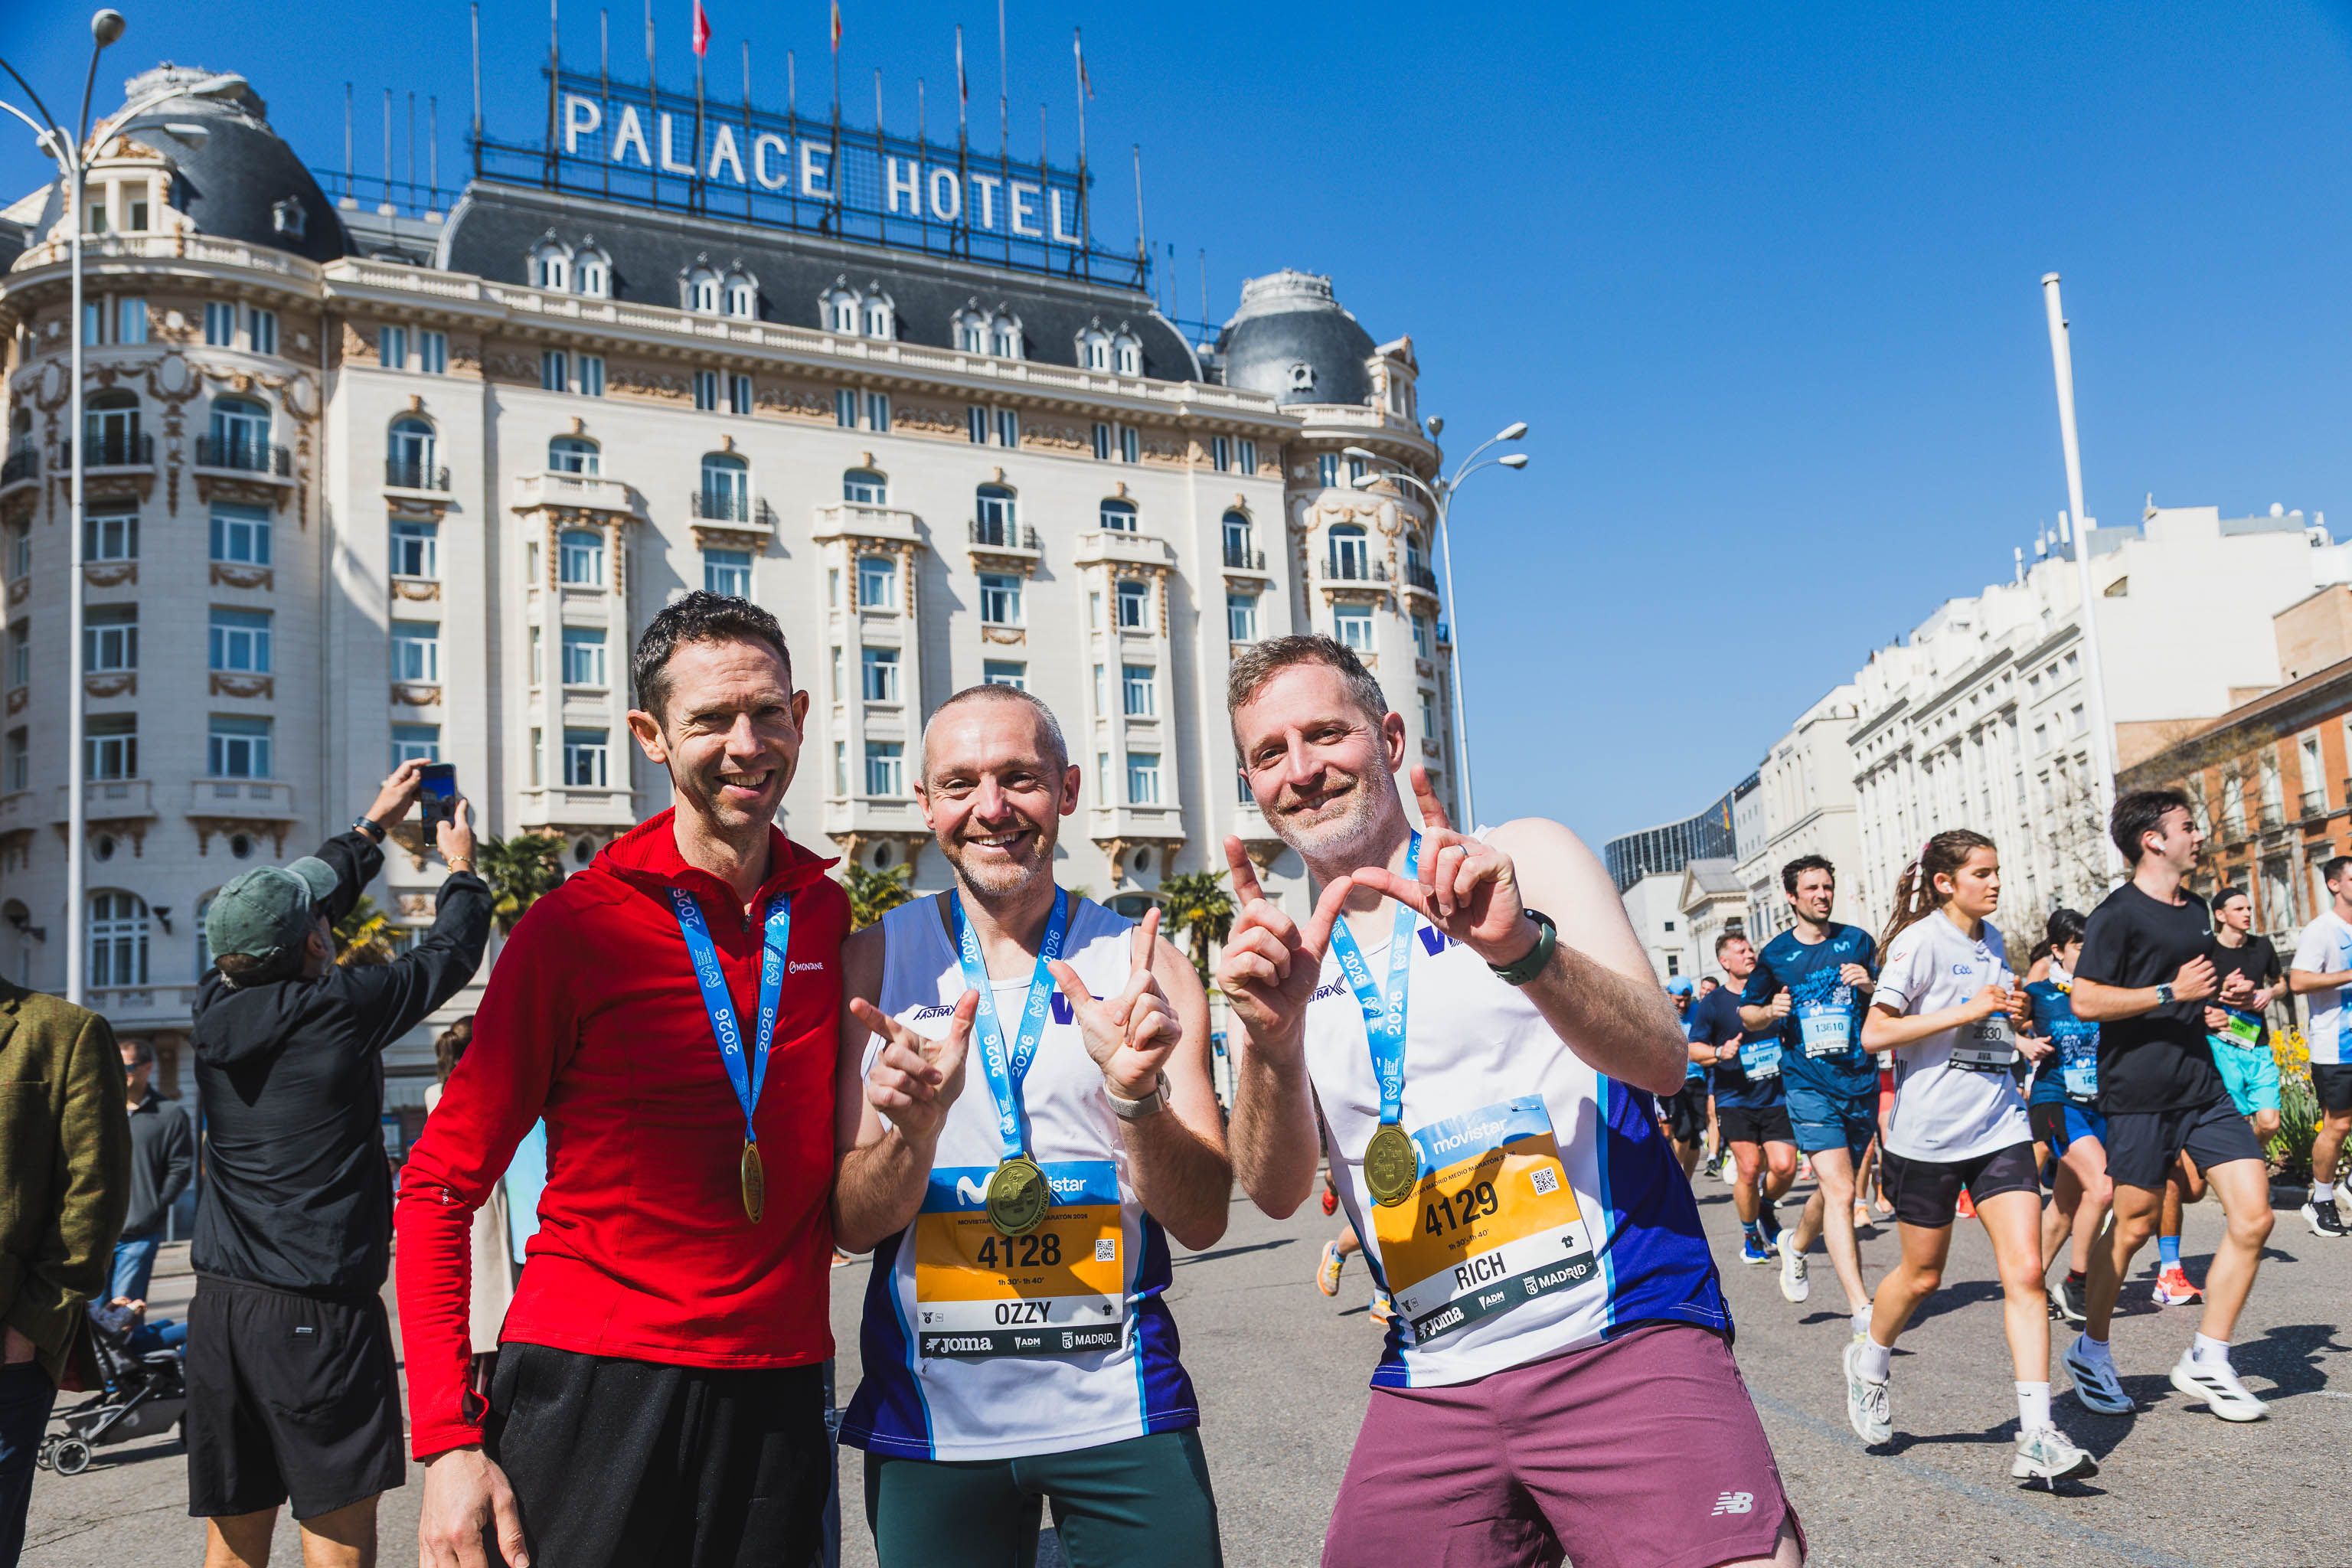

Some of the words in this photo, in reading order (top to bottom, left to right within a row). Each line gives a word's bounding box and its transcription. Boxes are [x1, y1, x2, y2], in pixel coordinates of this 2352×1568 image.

[565, 93, 833, 201] PALACE
[886, 156, 1081, 245] HOTEL
[960, 929, 978, 964] 2026
[1042, 929, 1060, 964] 2026
[796, 962, 824, 971] MONTANE
[1341, 950, 1367, 986] 2026
[715, 1008, 738, 1055] 2026
[759, 1007, 773, 1054] 2026
[1387, 991, 1404, 1036] 2026
[983, 1034, 1004, 1078] 2026
[1011, 1034, 1034, 1078] 2026
[1433, 1119, 1508, 1155] movistar
[1047, 1176, 1086, 1193] istar
[1426, 1177, 1448, 1191] MADRID
[1448, 1168, 1468, 1181] MEDIO
[1426, 1181, 1498, 1237] 4129
[978, 1233, 1061, 1269] 4128
[1455, 1252, 1507, 1291] RICH
[1539, 1263, 1587, 1289] MADRID
[995, 1301, 1052, 1325] OZZY
[1485, 1291, 1505, 1305] ADM
[1021, 1338, 1041, 1346] ADM
[1075, 1333, 1112, 1346] MADRID
